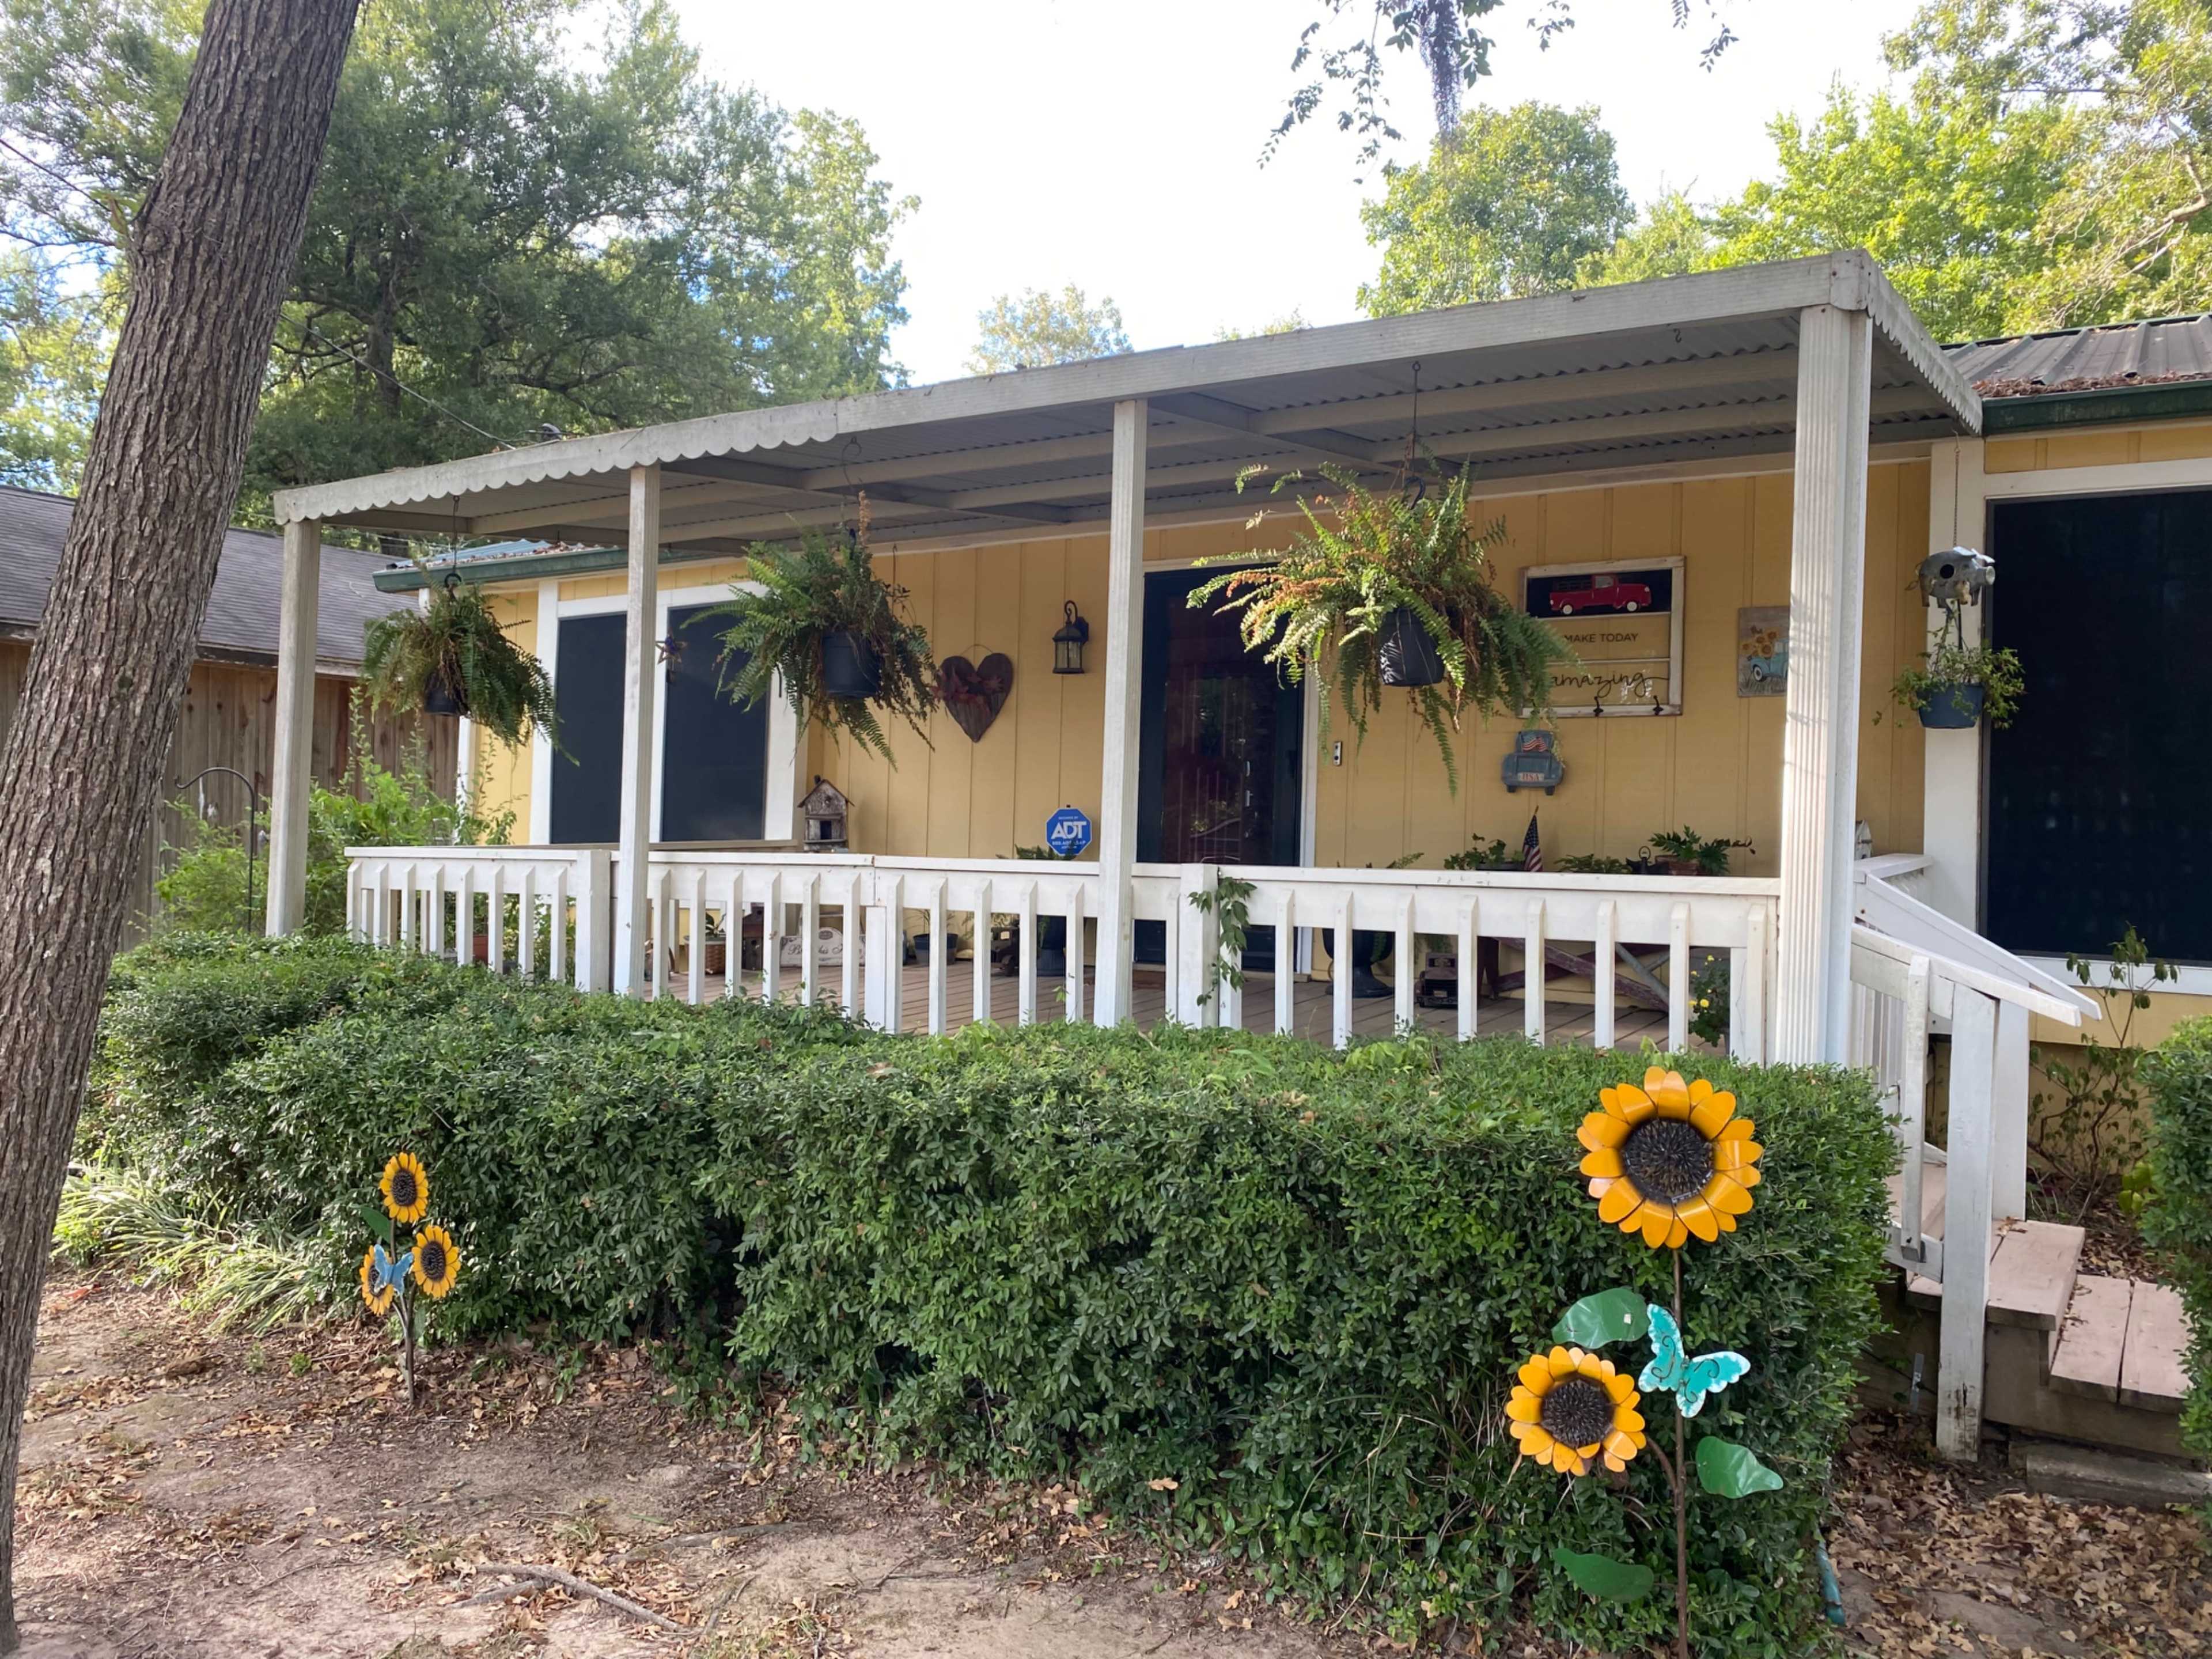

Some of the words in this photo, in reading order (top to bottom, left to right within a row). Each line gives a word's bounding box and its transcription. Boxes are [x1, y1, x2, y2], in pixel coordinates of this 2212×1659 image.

[1564, 634, 1596, 643] MAKE
[1600, 633, 1639, 642] TODAY
[1552, 671, 1669, 698] amazing
[1521, 772, 1540, 782] USA
[1050, 821, 1087, 840] ADT
